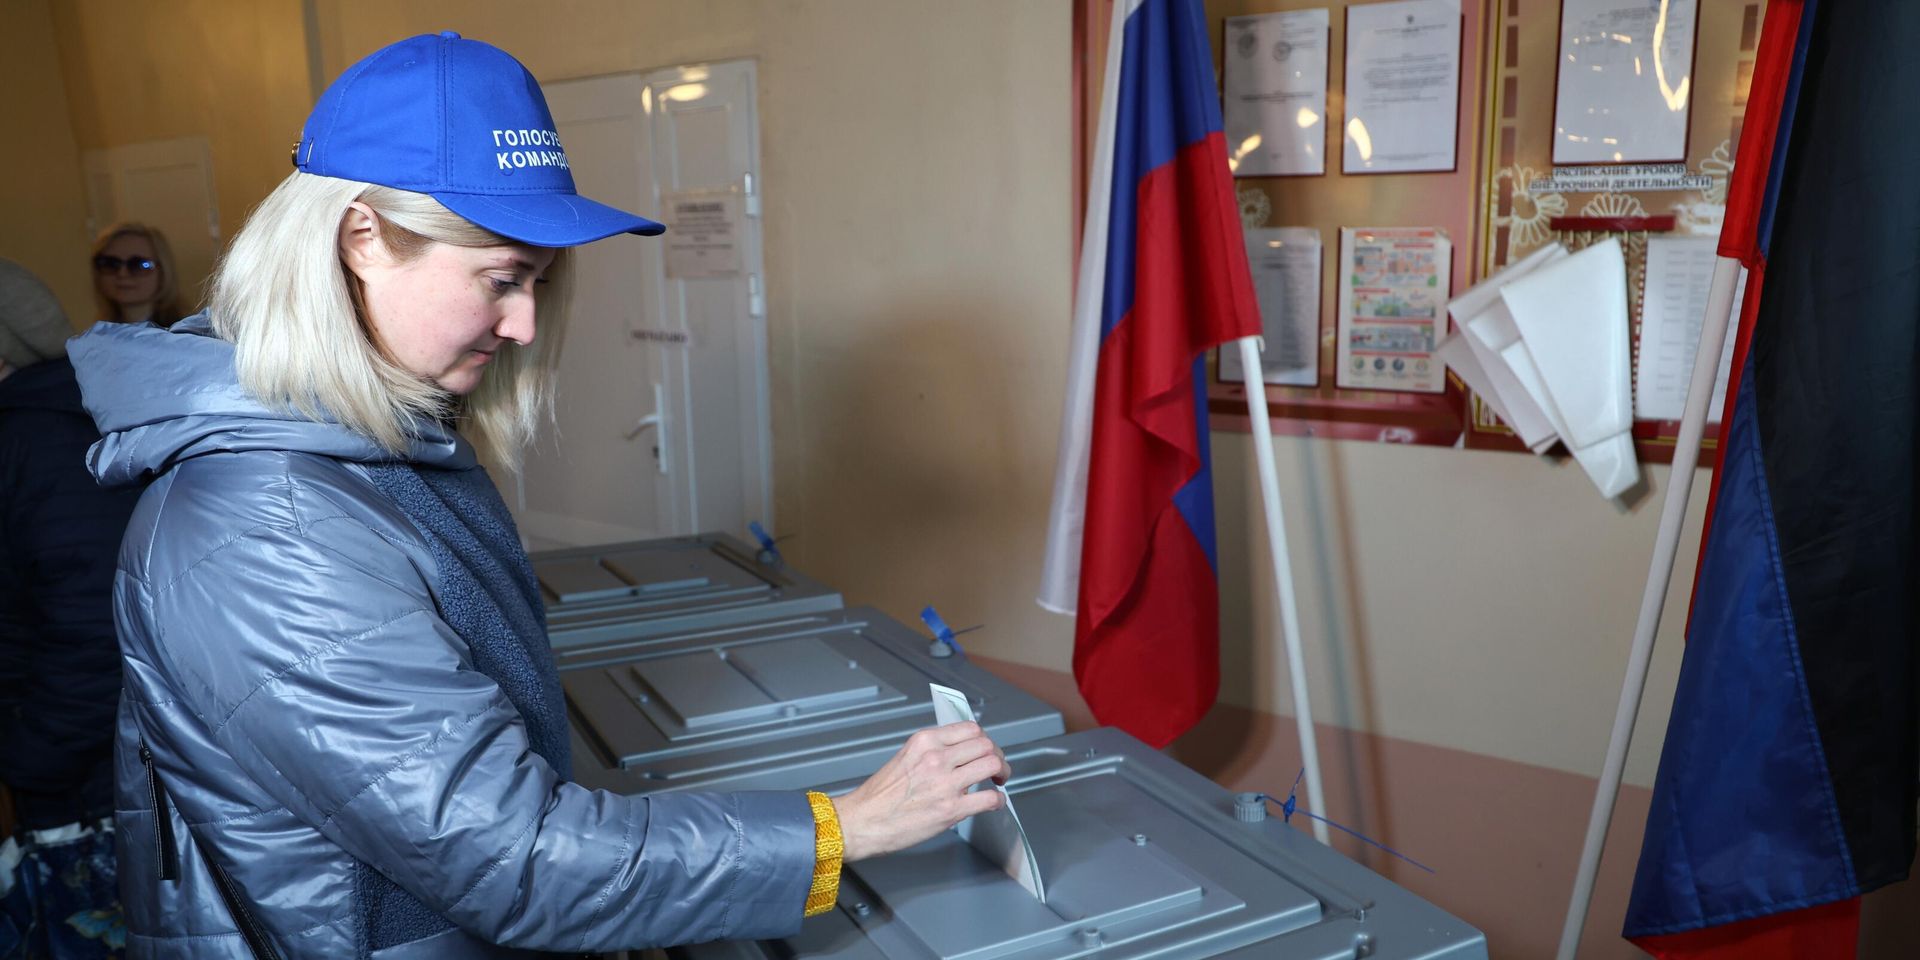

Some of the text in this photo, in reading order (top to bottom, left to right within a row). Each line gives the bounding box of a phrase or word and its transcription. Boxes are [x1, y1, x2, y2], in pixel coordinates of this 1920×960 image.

[1555, 164, 1684, 177] РАСПИСАНИЕ УРОКОВ
[1531, 176, 1709, 190] ВНЕУРОЧНОЙ ДЕЯТЕЛЬНОСТИ
